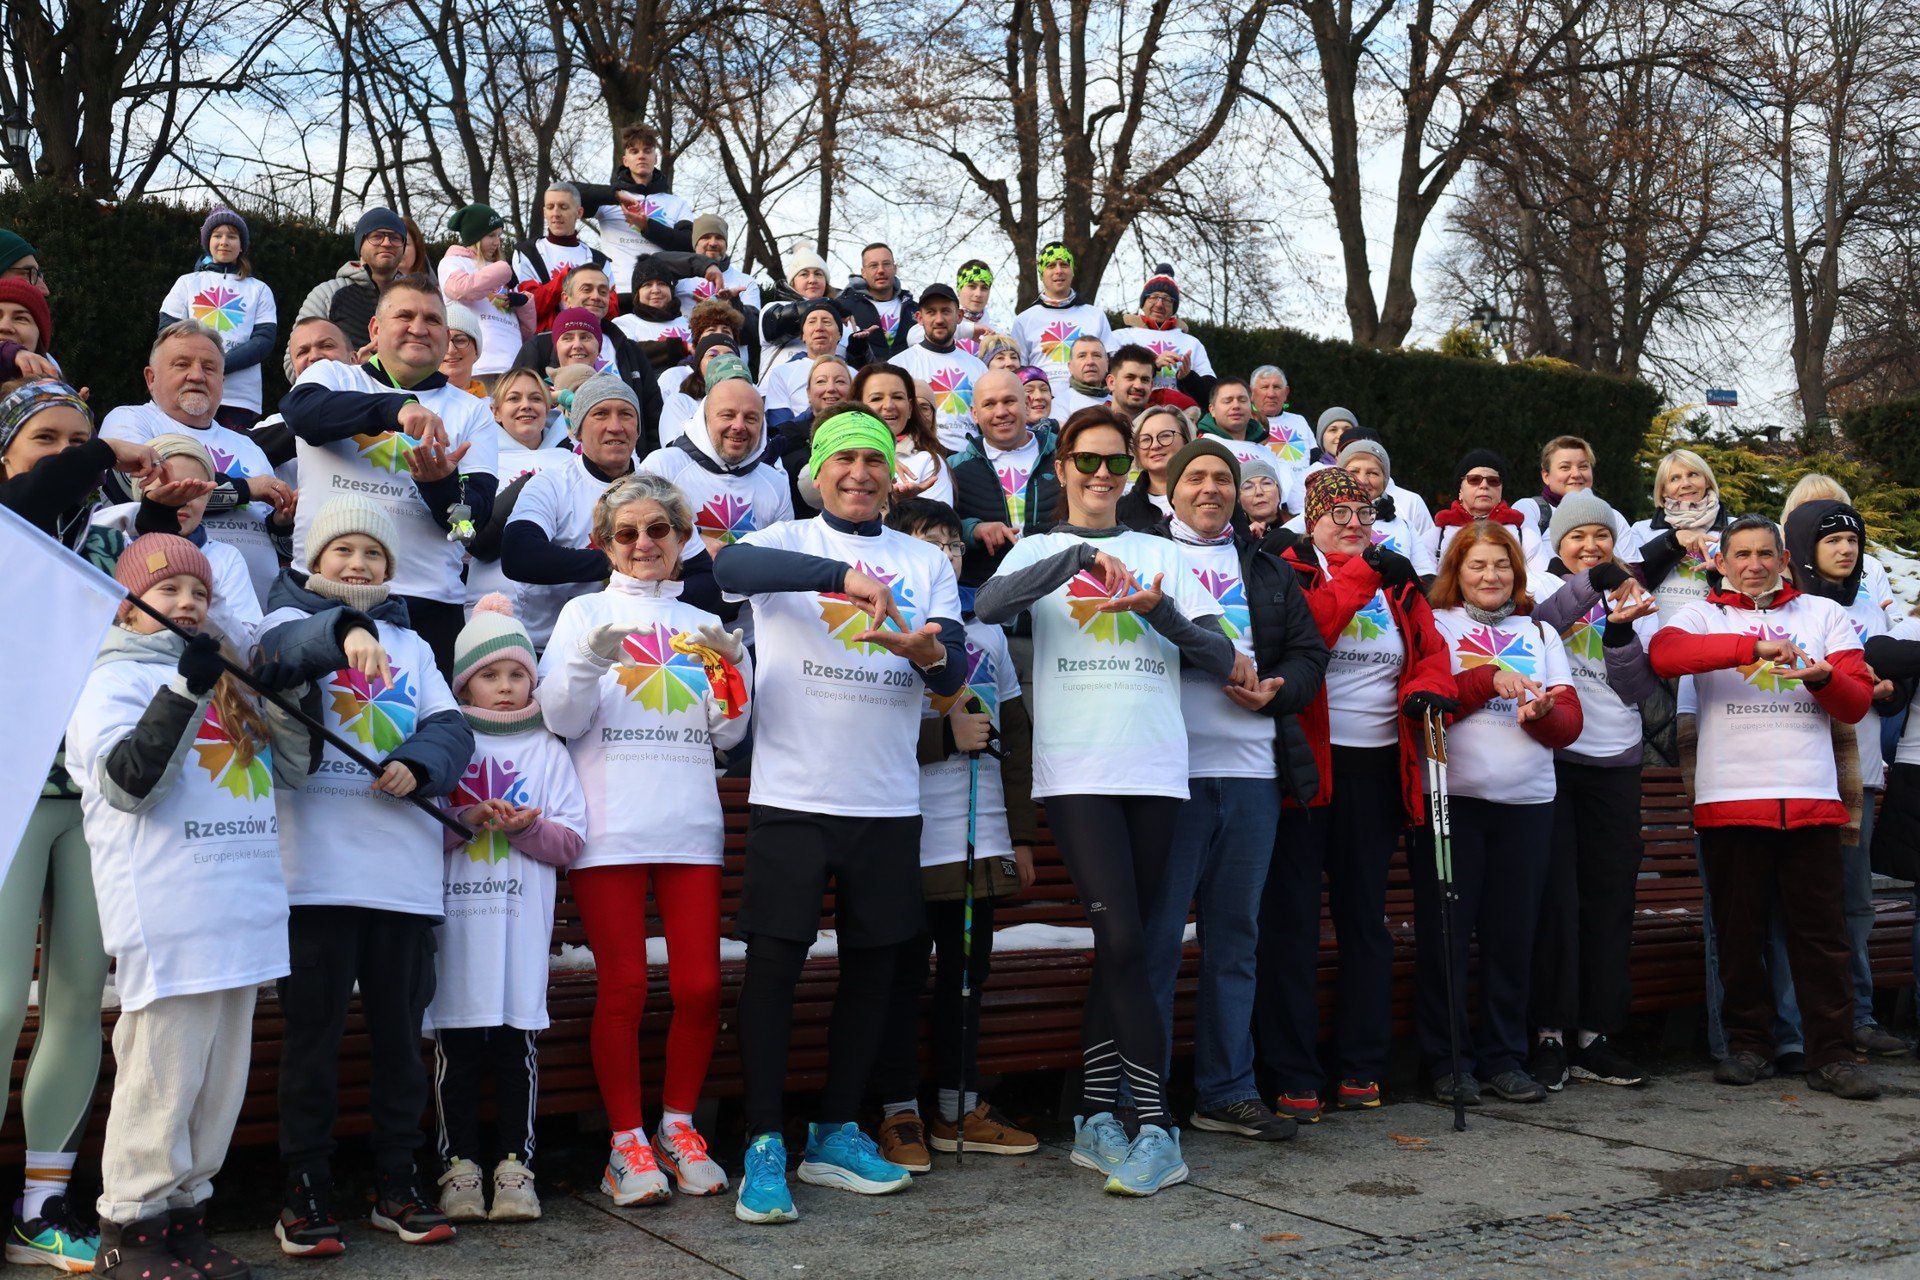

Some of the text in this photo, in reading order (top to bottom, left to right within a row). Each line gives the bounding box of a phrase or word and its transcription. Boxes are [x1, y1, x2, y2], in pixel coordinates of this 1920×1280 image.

[332, 474, 421, 499] Rzeszów 2
[251, 521, 266, 532] 20
[1330, 649, 1370, 662] szów
[803, 660, 914, 688] Rzeszów 2026
[1057, 656, 1166, 676] Rzeszów 2026
[1062, 682, 1112, 692] Europejskie
[1114, 682, 1142, 691] Miasto
[805, 687, 857, 702] Europejskie
[859, 694, 888, 706] Miasto
[1726, 702, 1820, 715] Rzeszów 202
[601, 725, 711, 745] Rzeszów 202
[605, 751, 658, 762] Europejskie
[660, 753, 690, 763] Miasto
[320, 759, 369, 776] zesz
[306, 784, 371, 798] Europejskie
[1432, 790, 1440, 822] LEKI
[184, 815, 278, 839] Rzeszów 2
[193, 849, 251, 864] Europejskie
